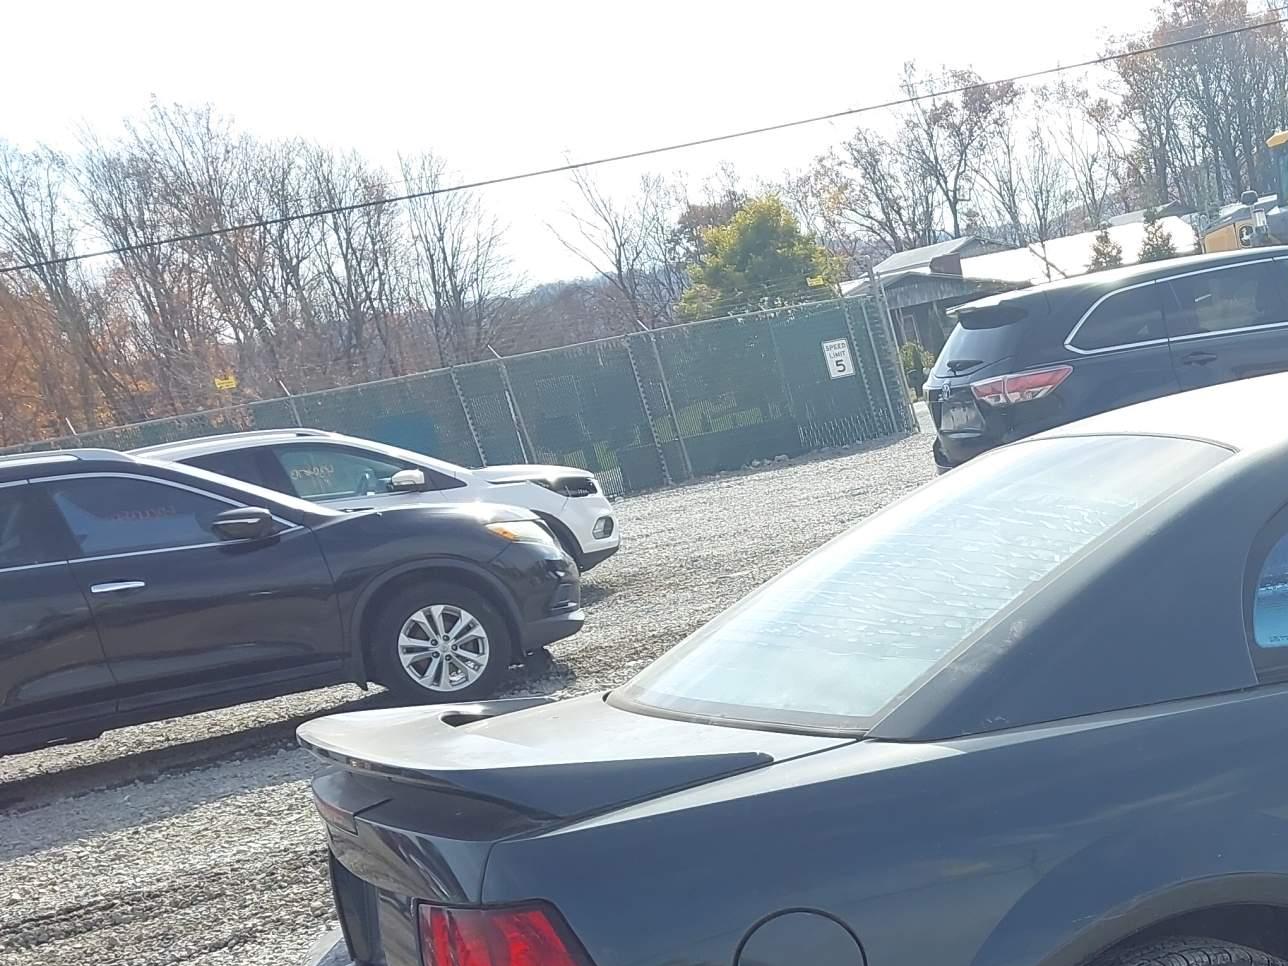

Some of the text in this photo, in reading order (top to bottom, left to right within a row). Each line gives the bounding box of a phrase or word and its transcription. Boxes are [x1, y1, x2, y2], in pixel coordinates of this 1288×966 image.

[825, 343, 846, 351] SPEED
[829, 351, 846, 359] LIMIT
[835, 359, 846, 372] 5
